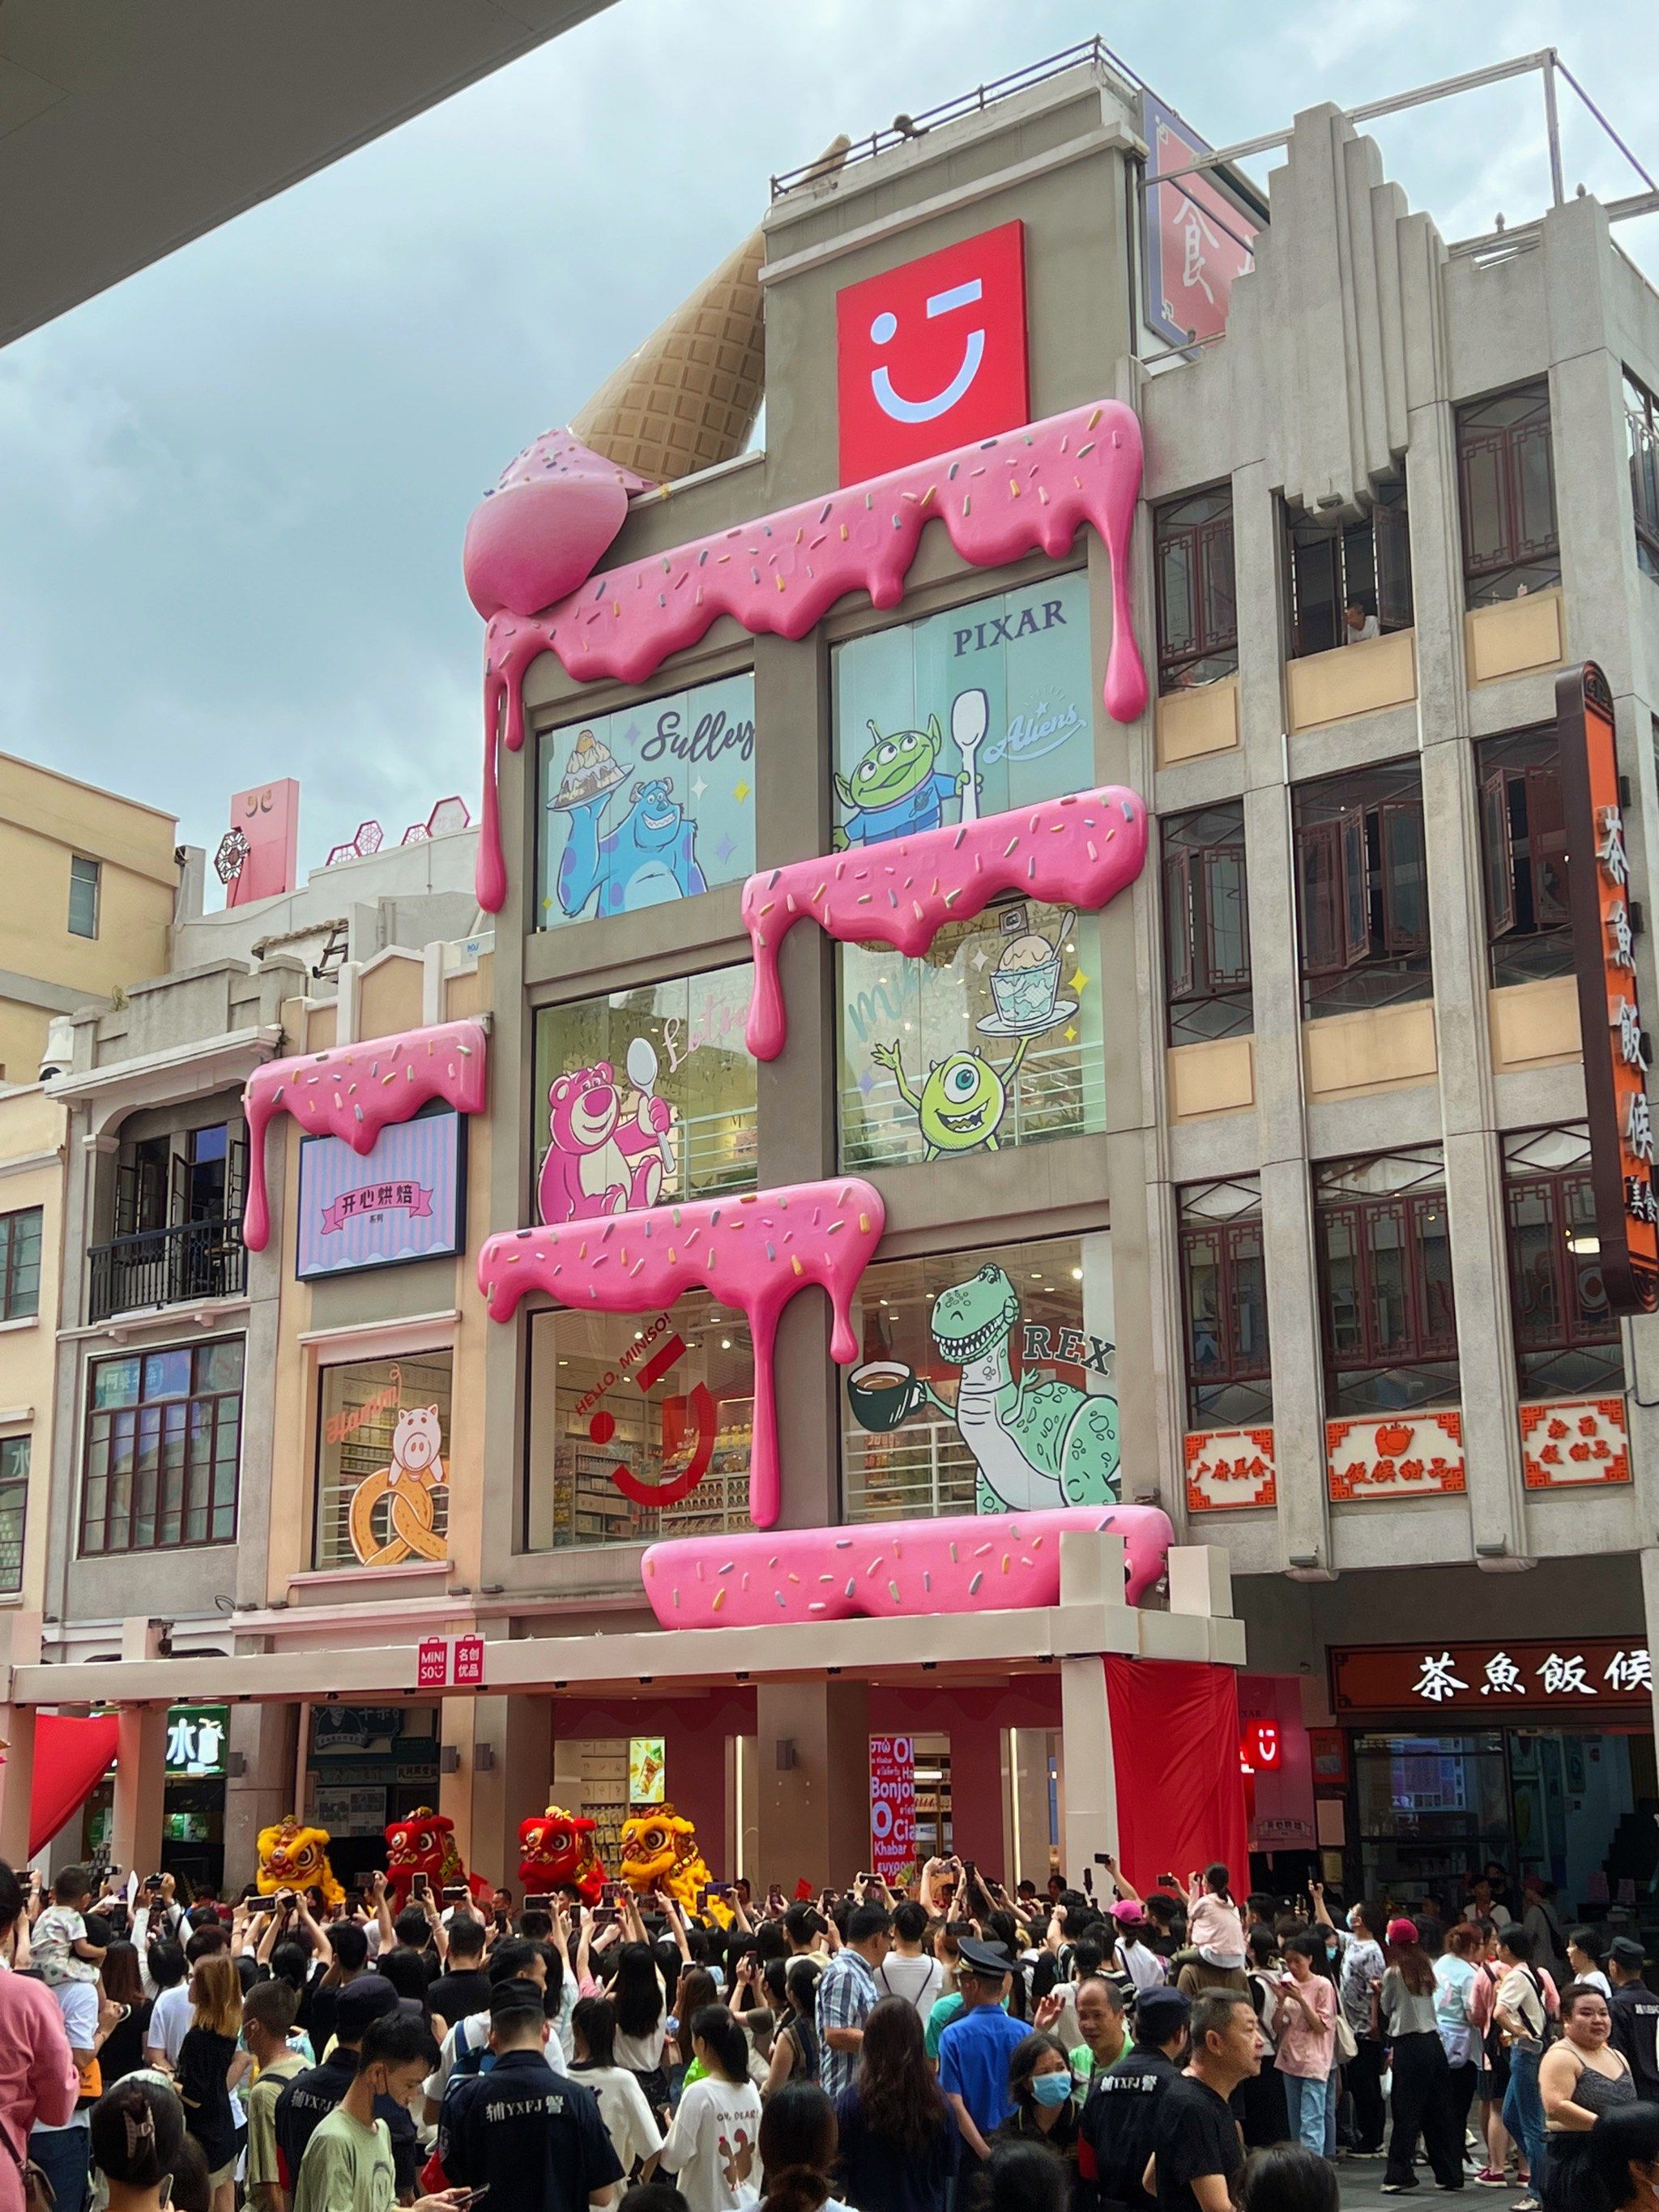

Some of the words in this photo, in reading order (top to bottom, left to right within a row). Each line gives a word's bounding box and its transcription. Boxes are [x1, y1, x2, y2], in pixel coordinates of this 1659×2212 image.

[953, 600, 1067, 657] PIXAR
[641, 711, 754, 762] Sulley
[983, 702, 1081, 764] Aliens
[342, 1184, 413, 1215] 开心烘焙
[575, 1371, 619, 1416] HELLO,
[618, 1312, 672, 1369] MINISO!
[1022, 1326, 1116, 1377] REX
[421, 1650, 445, 1663] MINI
[458, 1647, 480, 1662] 名创
[458, 1663, 480, 1678] 优品
[1411, 1650, 1653, 1702] 茶魚飯候
[165, 1717, 198, 1765] 水
[874, 1840, 906, 1856] Khabar
